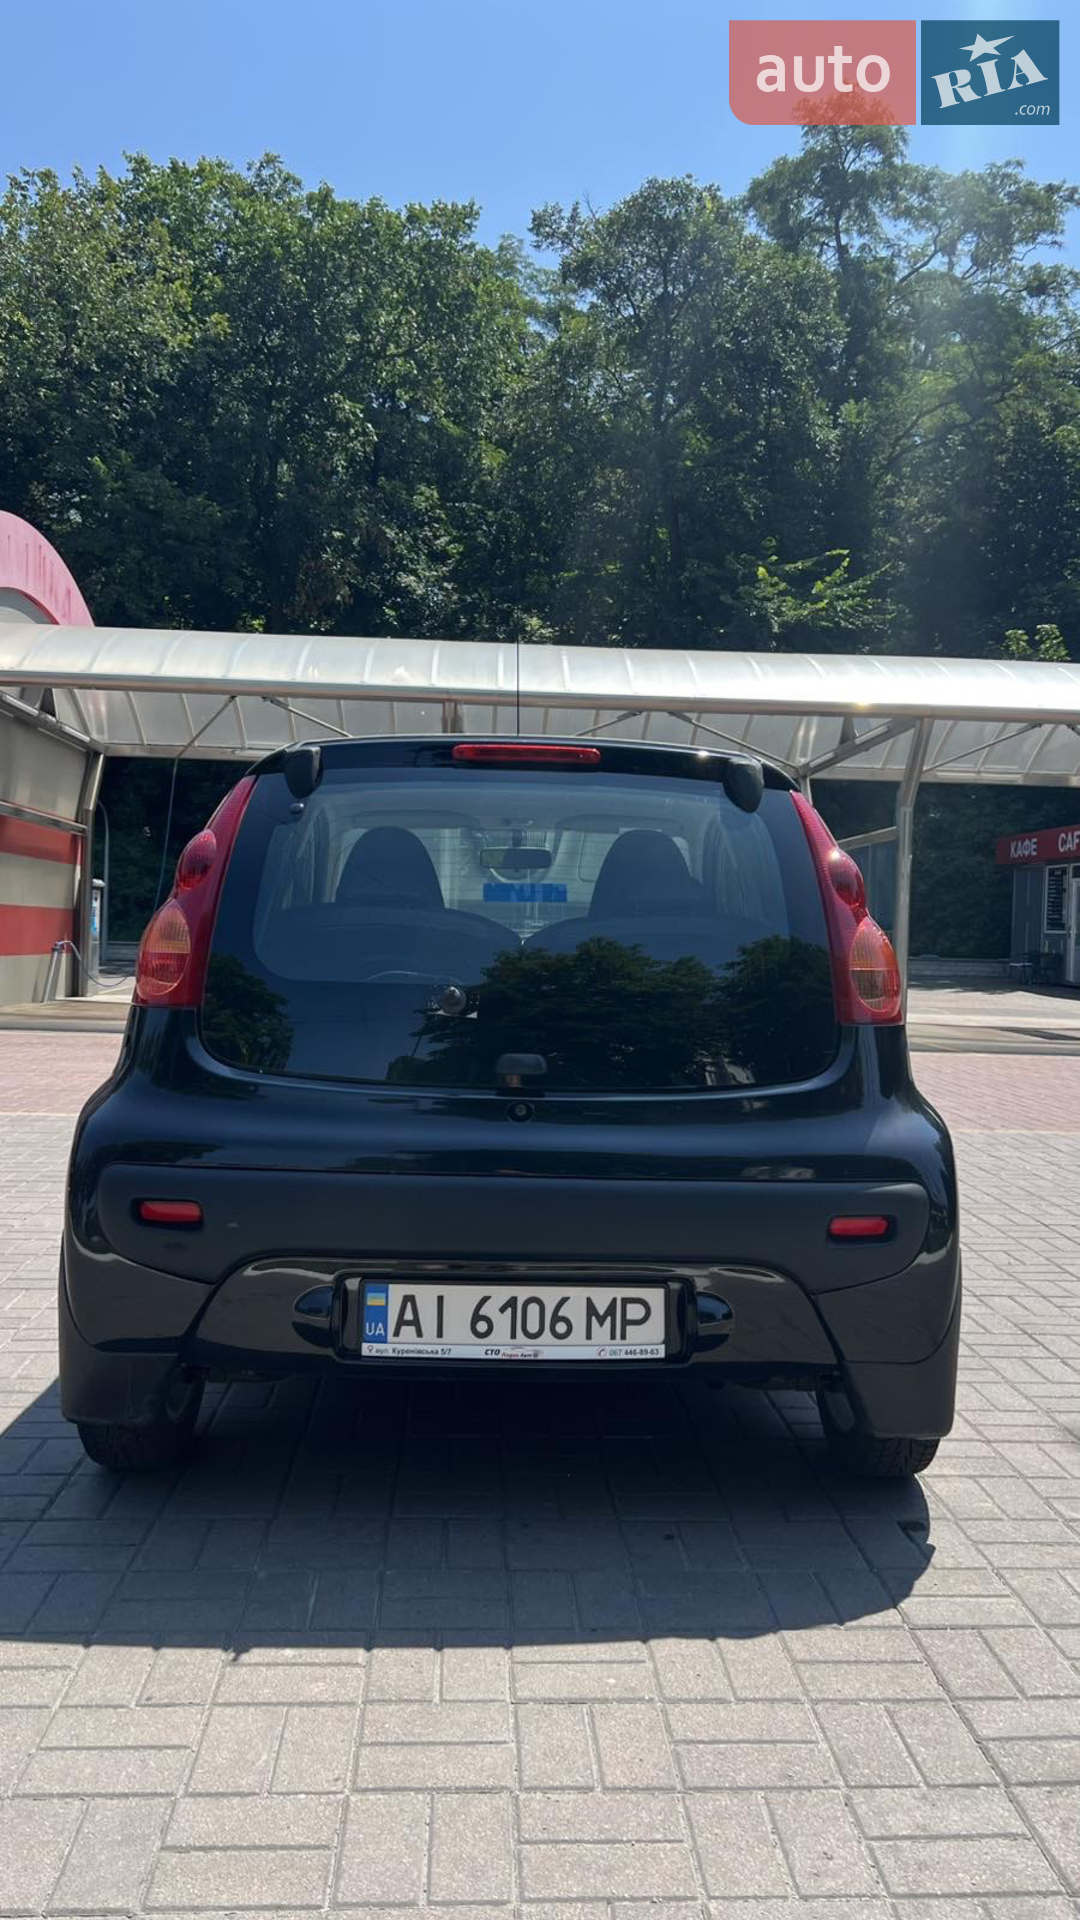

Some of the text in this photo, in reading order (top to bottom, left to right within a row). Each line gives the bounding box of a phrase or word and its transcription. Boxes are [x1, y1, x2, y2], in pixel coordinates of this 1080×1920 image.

[1009, 838, 1038, 858] КАФЕ
[470, 1295, 573, 1341] 6106
[585, 1296, 652, 1341] MP
[365, 1322, 385, 1337] UA
